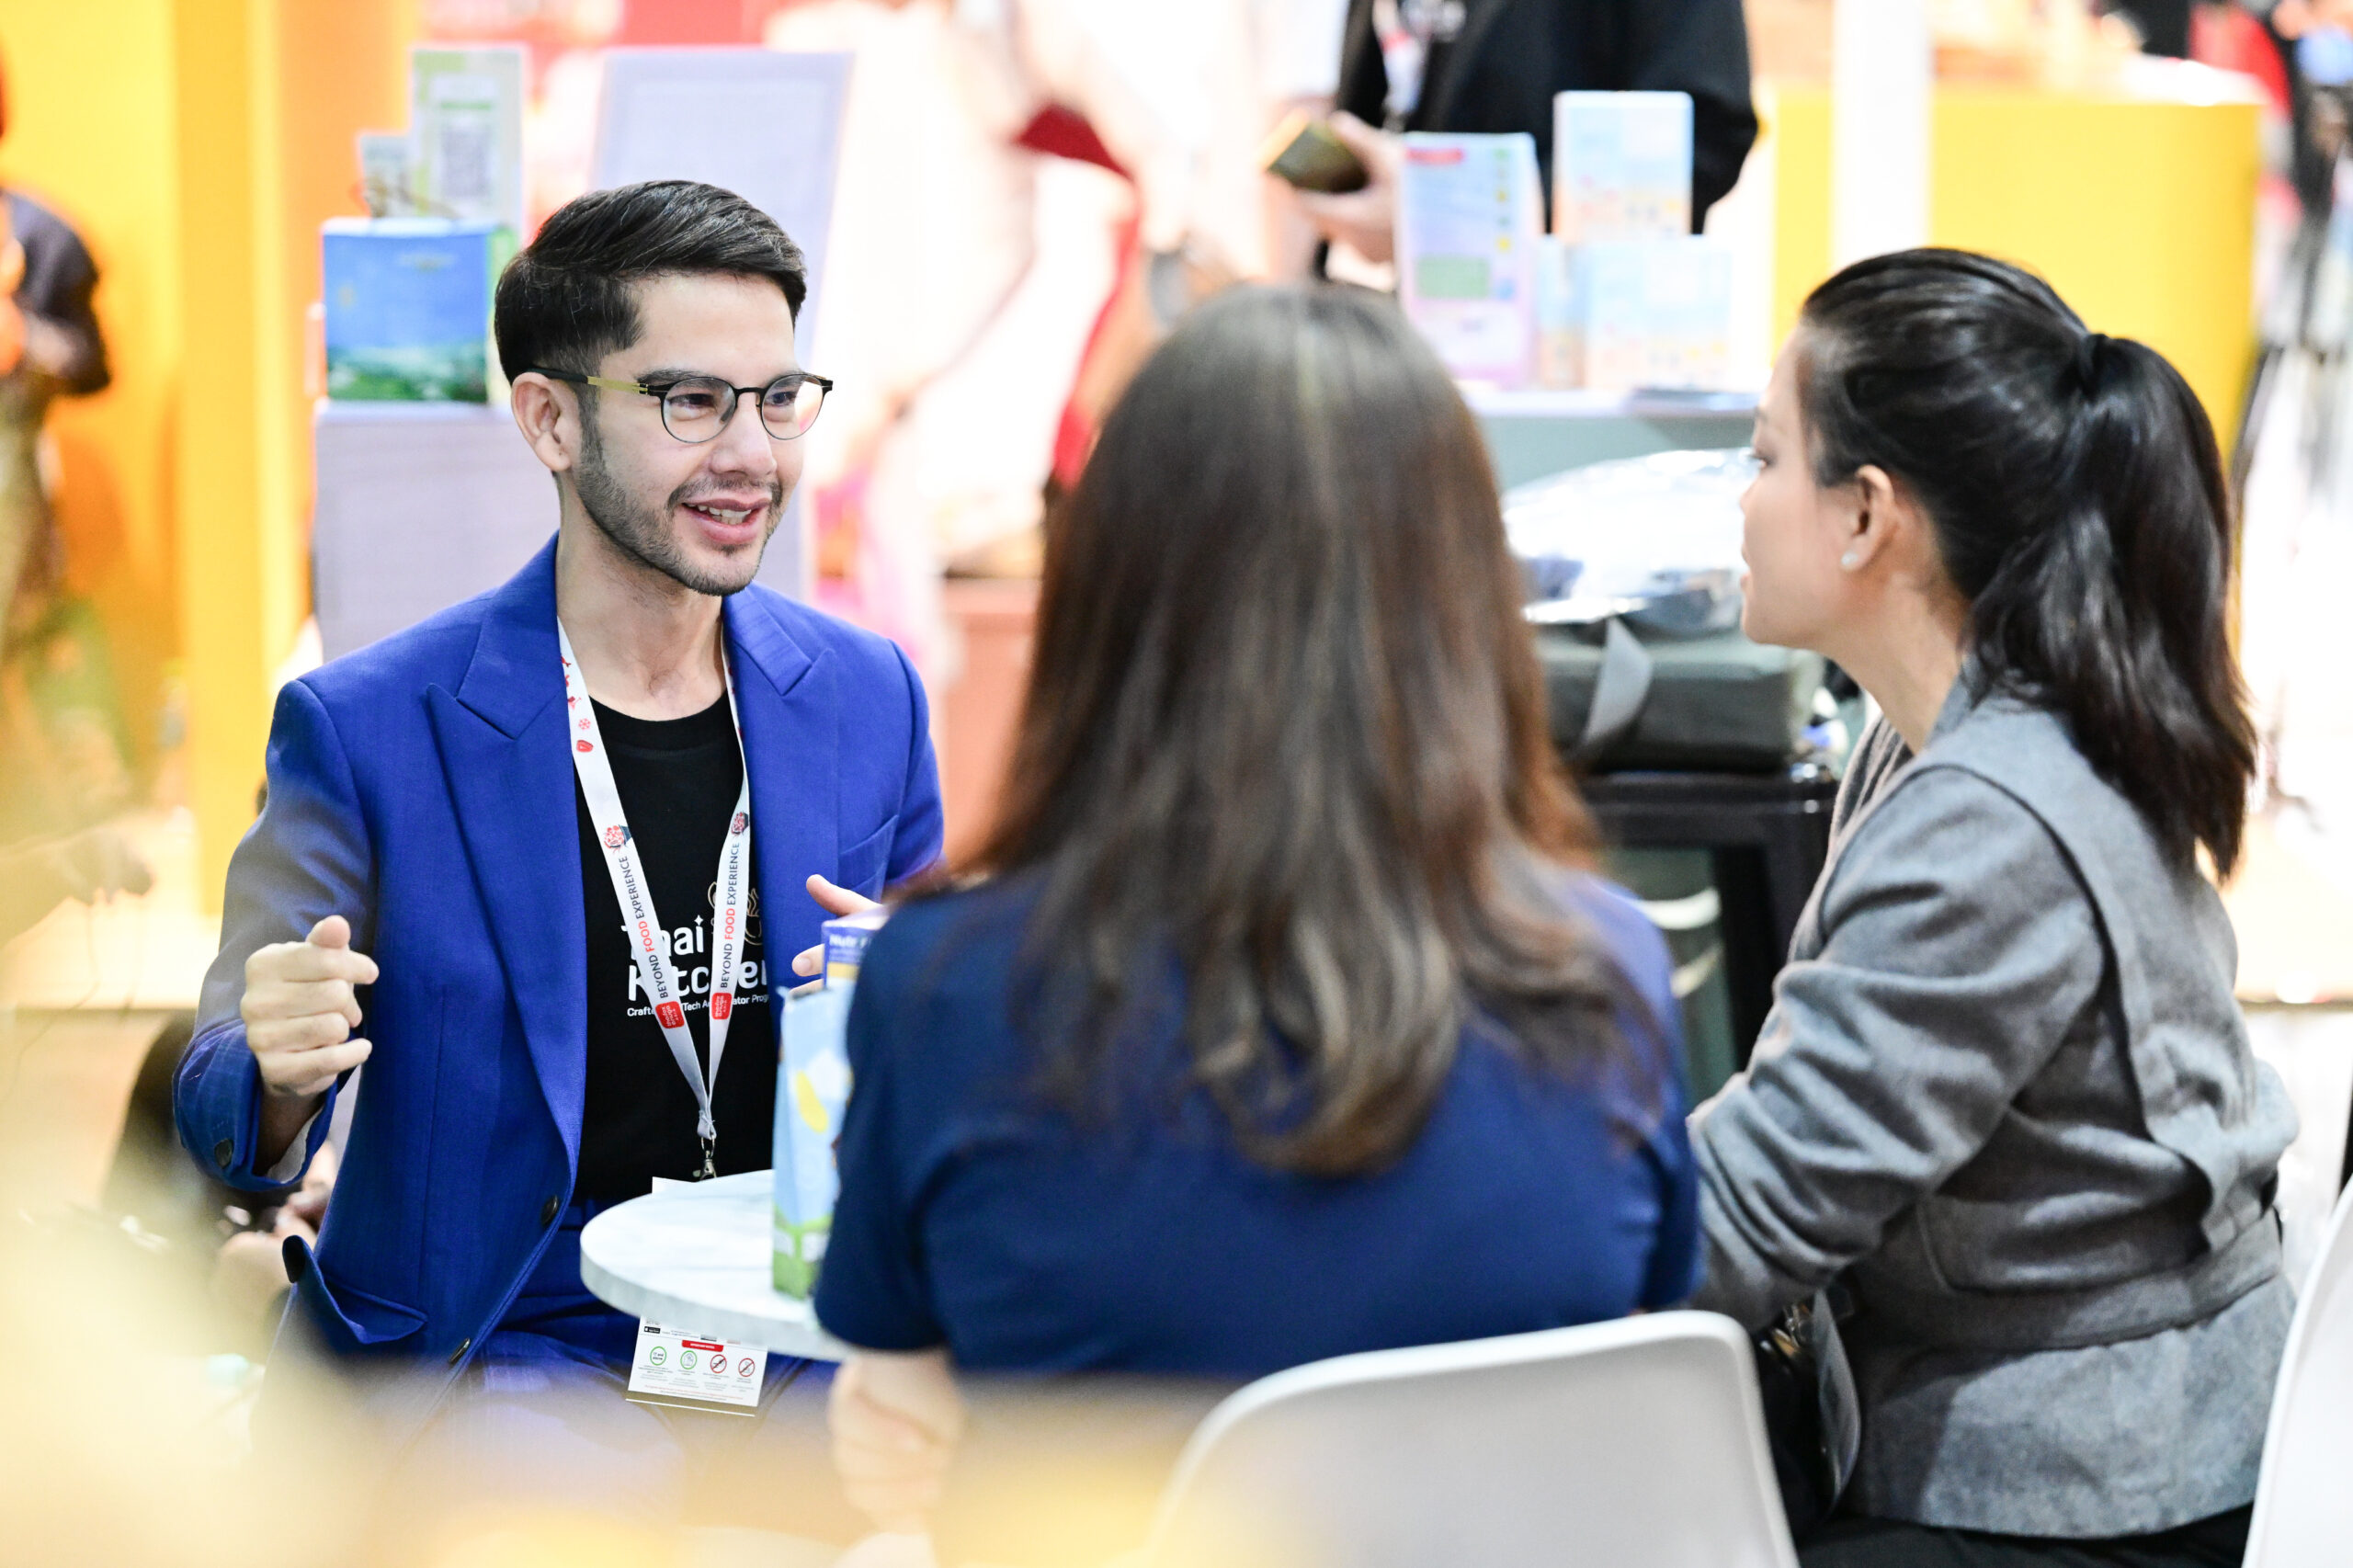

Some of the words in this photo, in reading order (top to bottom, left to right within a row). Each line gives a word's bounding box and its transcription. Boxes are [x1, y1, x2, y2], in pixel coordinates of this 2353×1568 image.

[619, 856, 645, 919] EXPERIENCE
[727, 843, 740, 905] EXPERIENCE
[620, 914, 704, 960] ai
[638, 920, 655, 952] FOOD
[724, 908, 736, 940] FOOD
[628, 960, 767, 1001] Ktce
[649, 954, 669, 999] BEYOND
[721, 943, 733, 988] BEYOND
[627, 1006, 655, 1017] Crafte
[682, 1000, 701, 1012] Tech
[752, 994, 769, 1005] Prog
